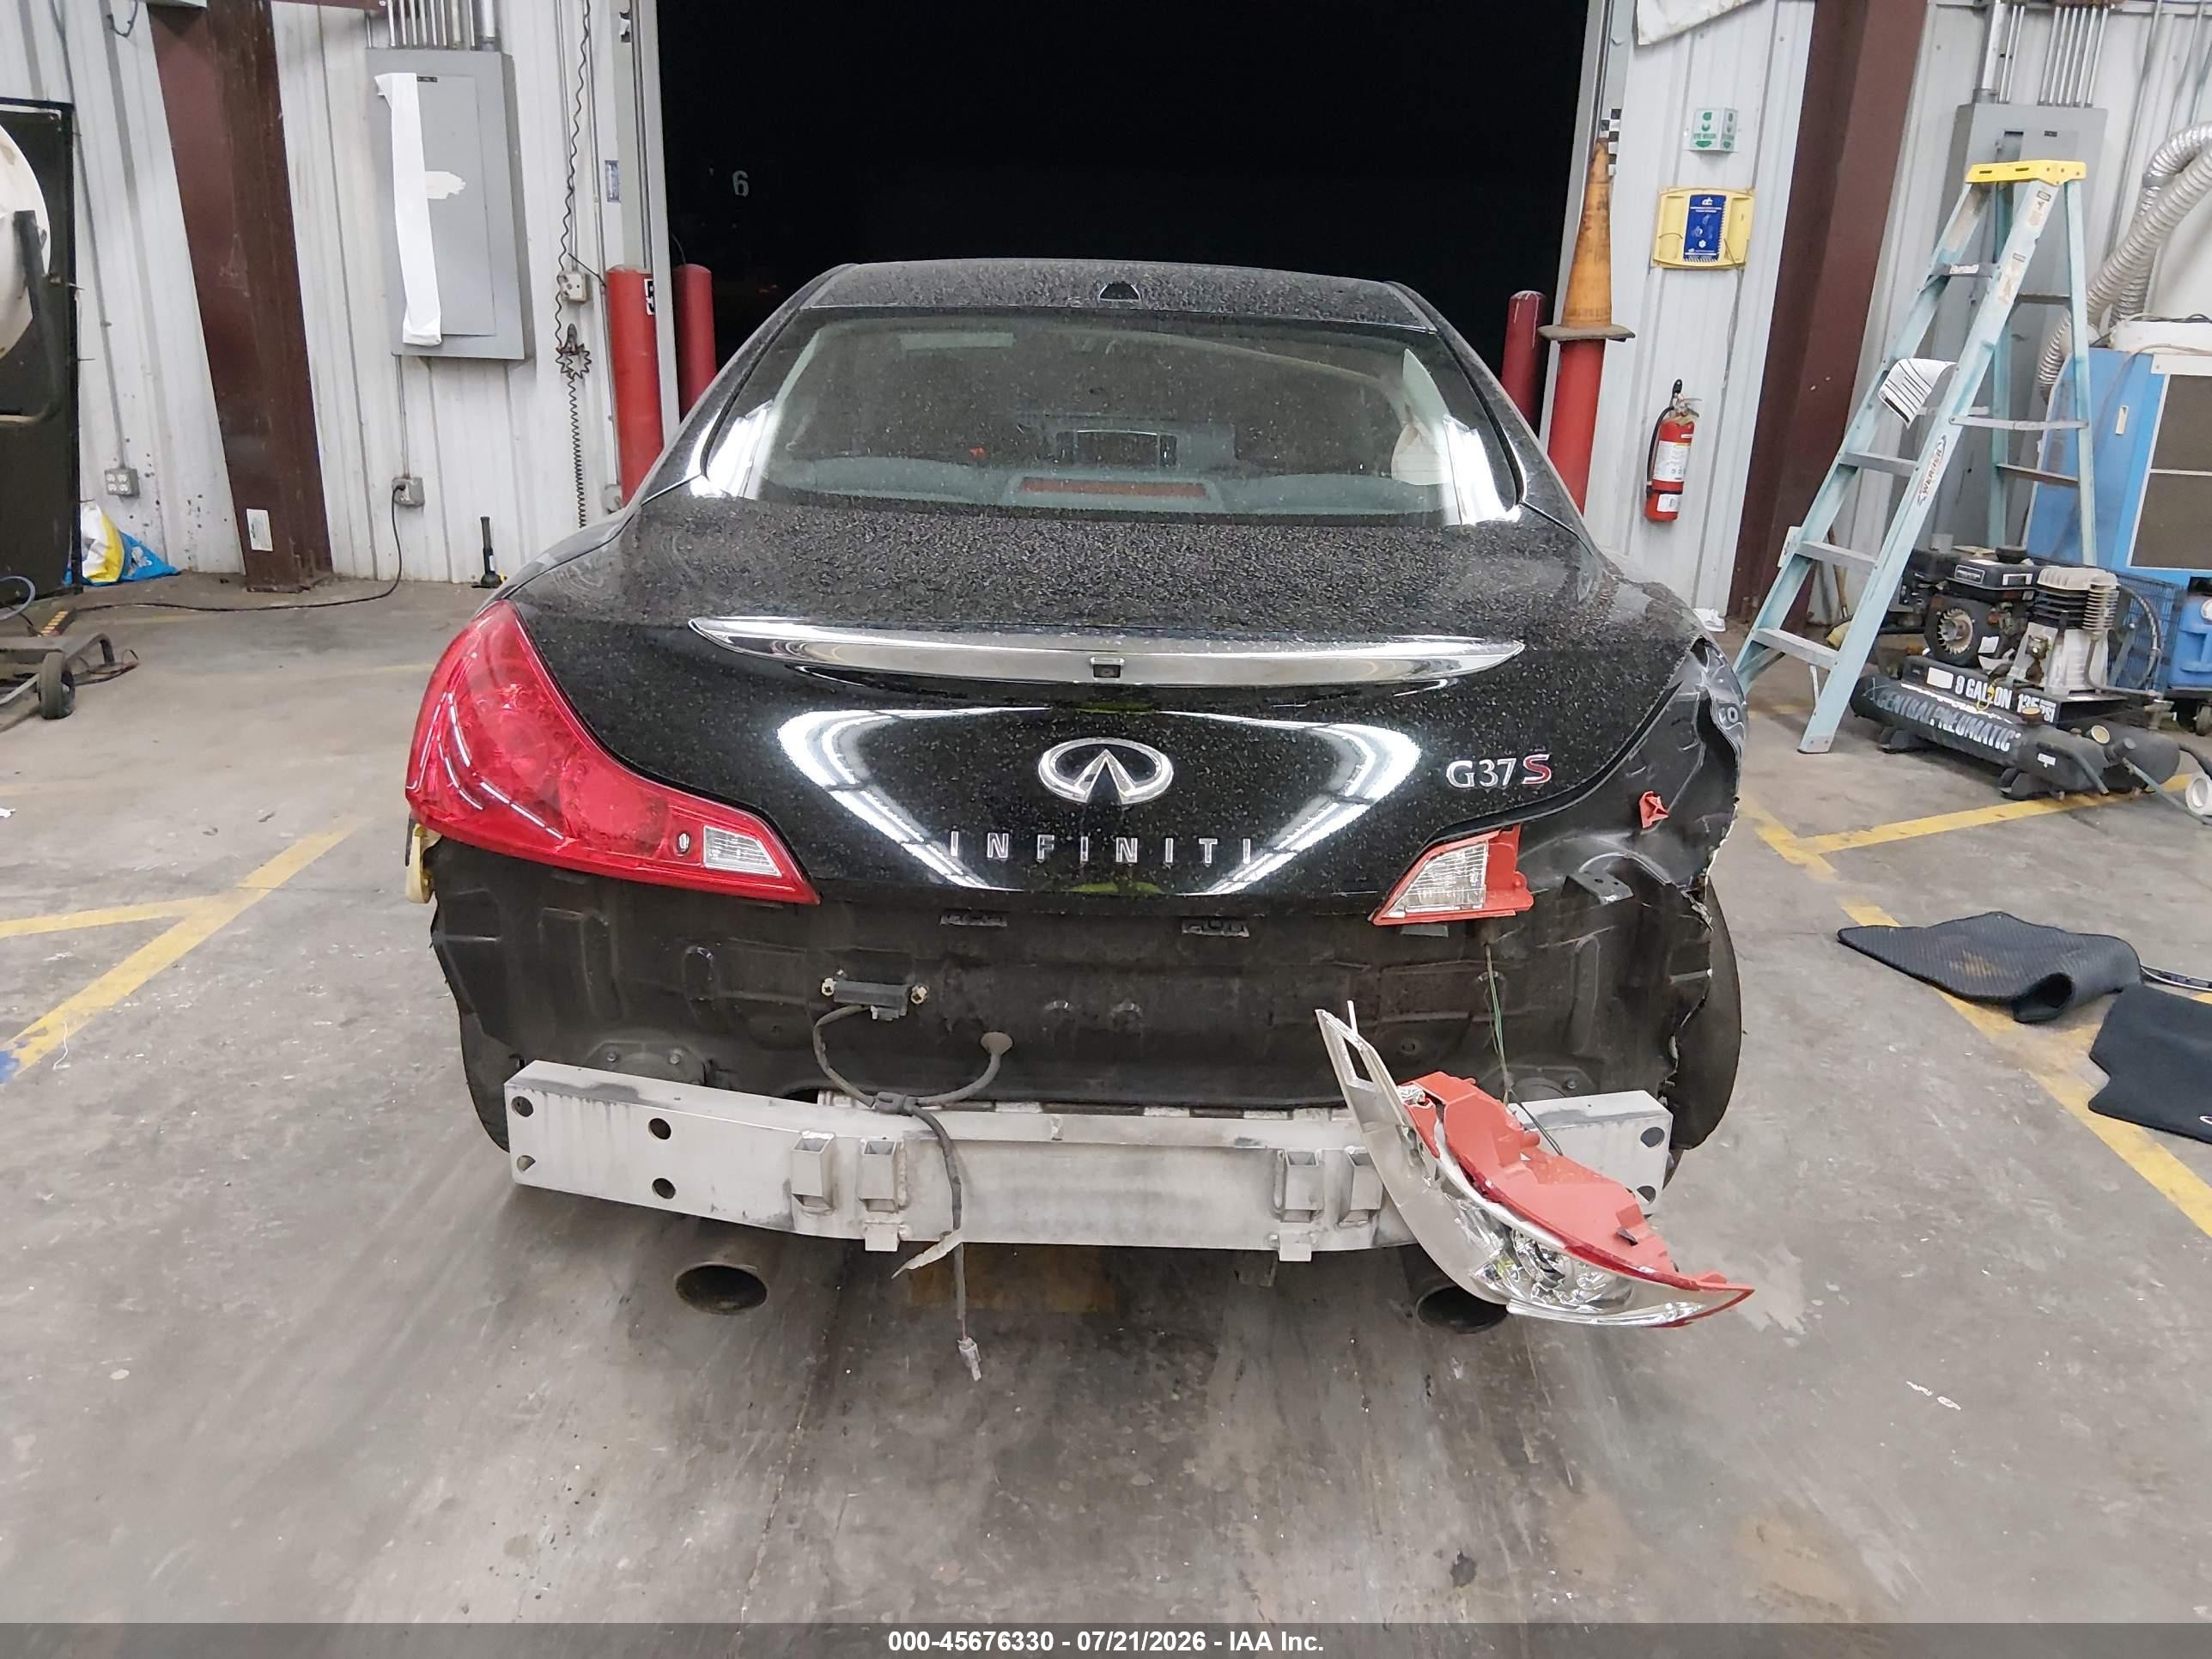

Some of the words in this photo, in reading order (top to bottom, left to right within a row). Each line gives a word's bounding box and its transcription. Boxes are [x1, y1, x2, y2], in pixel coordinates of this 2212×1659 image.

[732, 171, 749, 198] 6
[1954, 675, 1966, 695] 9
[1965, 678, 2013, 710] GALON
[1932, 706, 2016, 752] PNEUMATIC
[950, 830, 1251, 865] INFINITI
